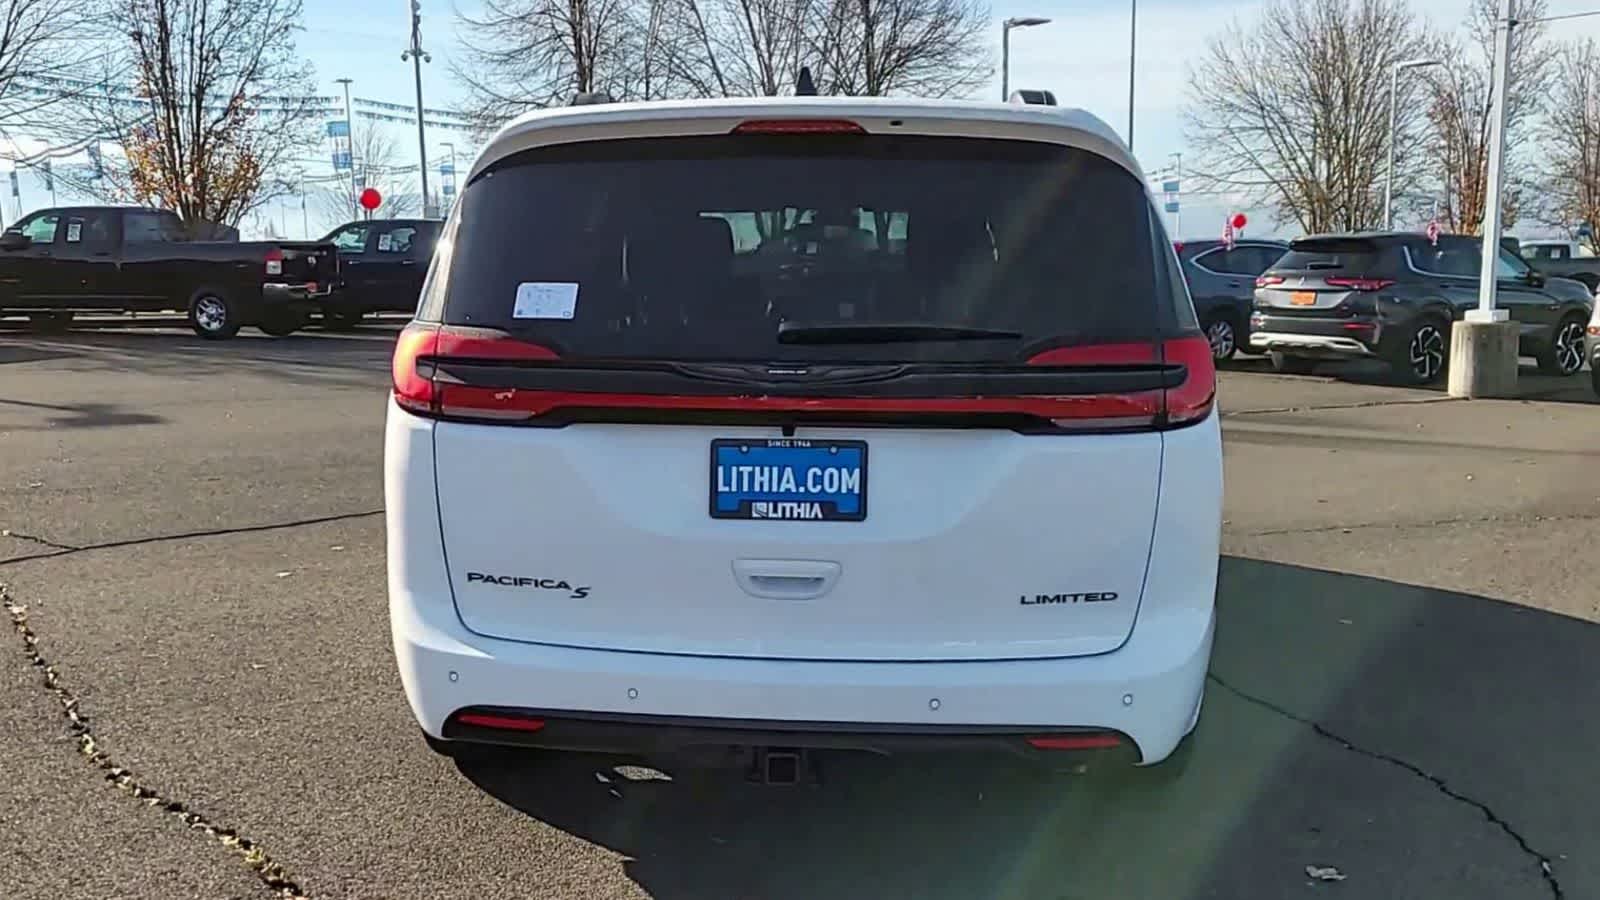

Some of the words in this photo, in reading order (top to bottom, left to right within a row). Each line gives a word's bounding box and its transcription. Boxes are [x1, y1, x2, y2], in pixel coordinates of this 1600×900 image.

[717, 465, 861, 494] LITHIA.COM
[768, 502, 823, 519] LITHIA
[467, 572, 572, 591] PACIFICA
[569, 586, 592, 599] S
[1020, 592, 1119, 605] LIMITED
